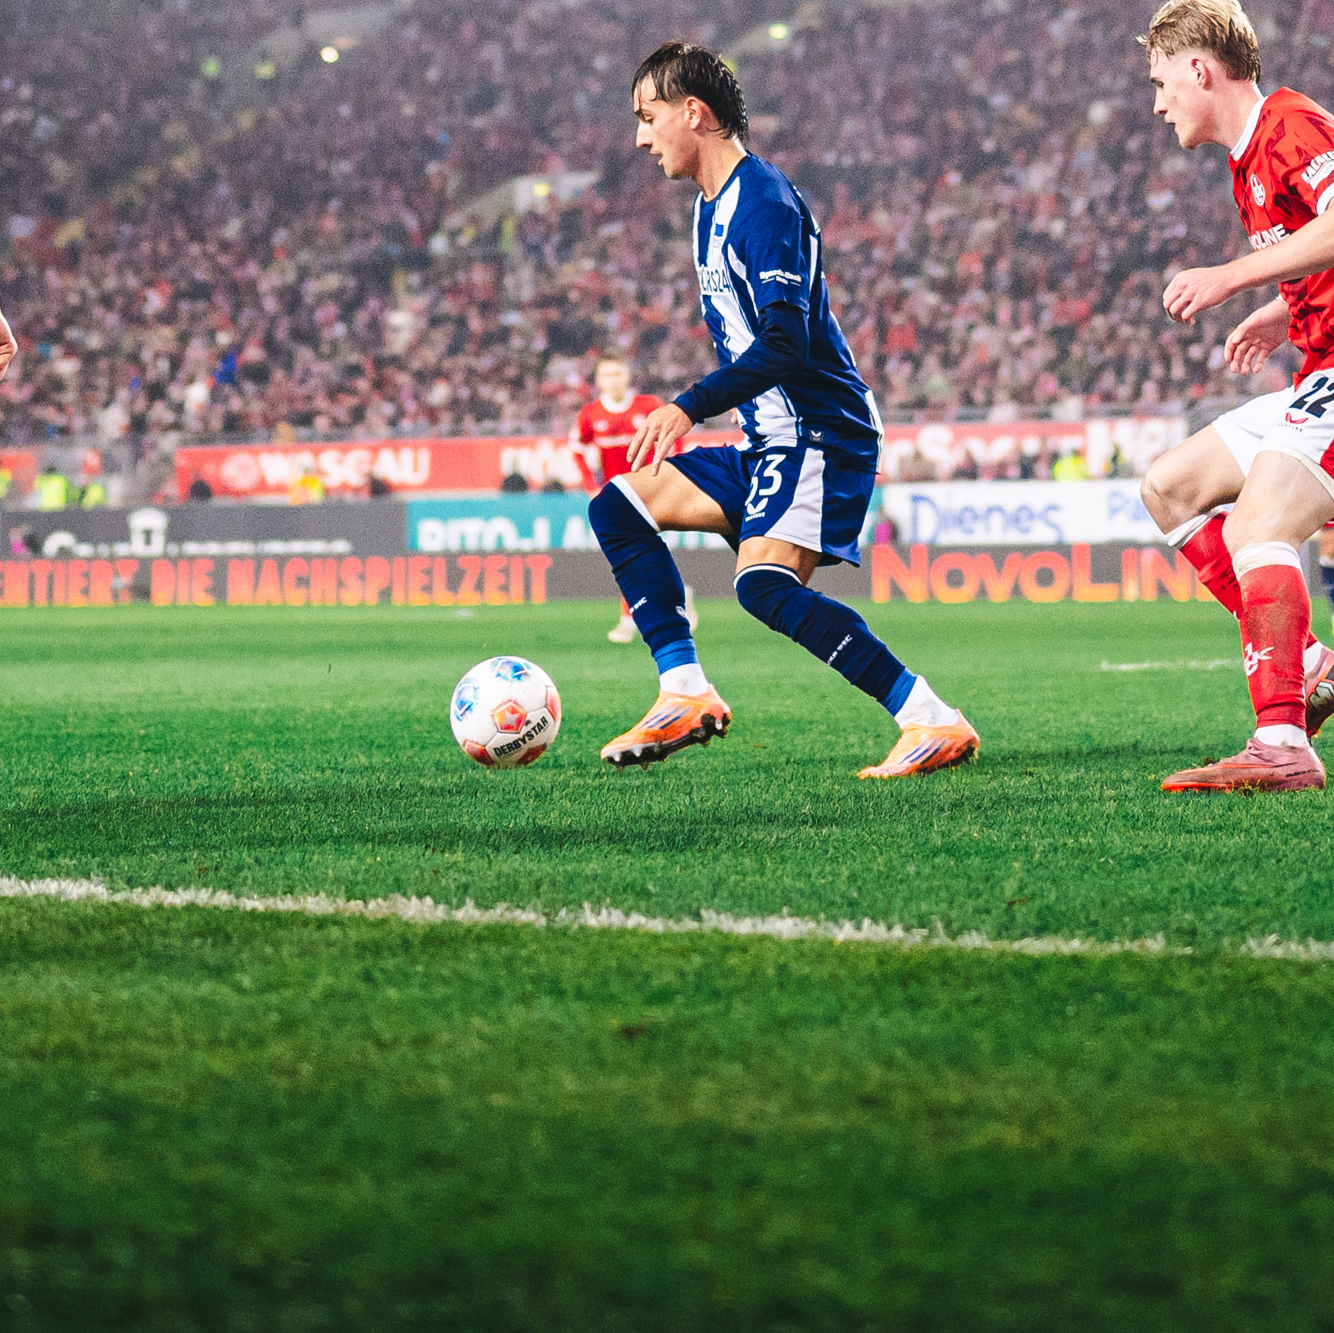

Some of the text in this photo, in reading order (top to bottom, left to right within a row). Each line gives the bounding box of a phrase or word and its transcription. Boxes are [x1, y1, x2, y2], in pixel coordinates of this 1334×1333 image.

[151, 557, 214, 607] DIE
[227, 554, 553, 607] NACHSPIELZEIT
[870, 544, 1229, 603] NOVOLIN
[493, 716, 549, 757] DERBYSTAR
